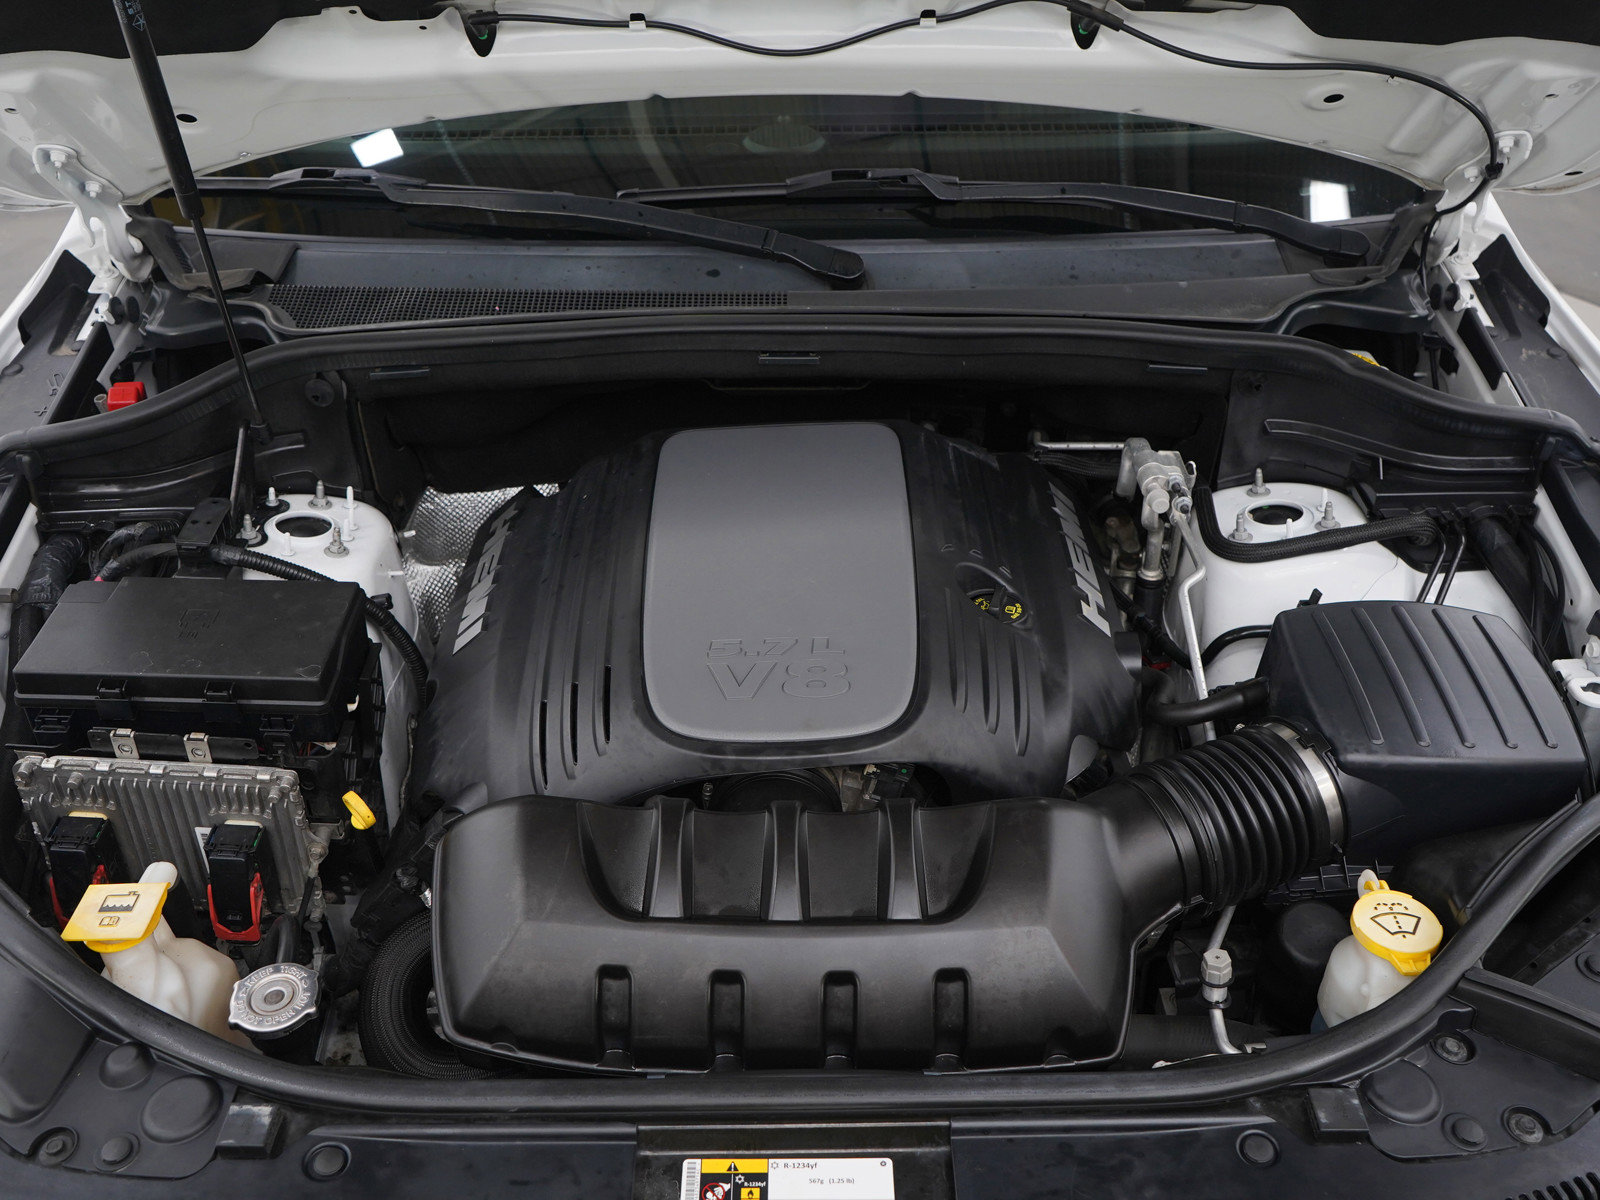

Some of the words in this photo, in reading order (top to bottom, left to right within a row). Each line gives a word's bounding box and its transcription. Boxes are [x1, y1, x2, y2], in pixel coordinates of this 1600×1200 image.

[1048, 481, 1112, 638] HEMI
[452, 501, 520, 655] HEMI
[706, 658, 851, 701] V8
[244, 967, 275, 987] KEEP
[280, 965, 308, 980] TIGHT
[265, 1009, 296, 1025] OPEN
[783, 1162, 818, 1170] R-1234yf
